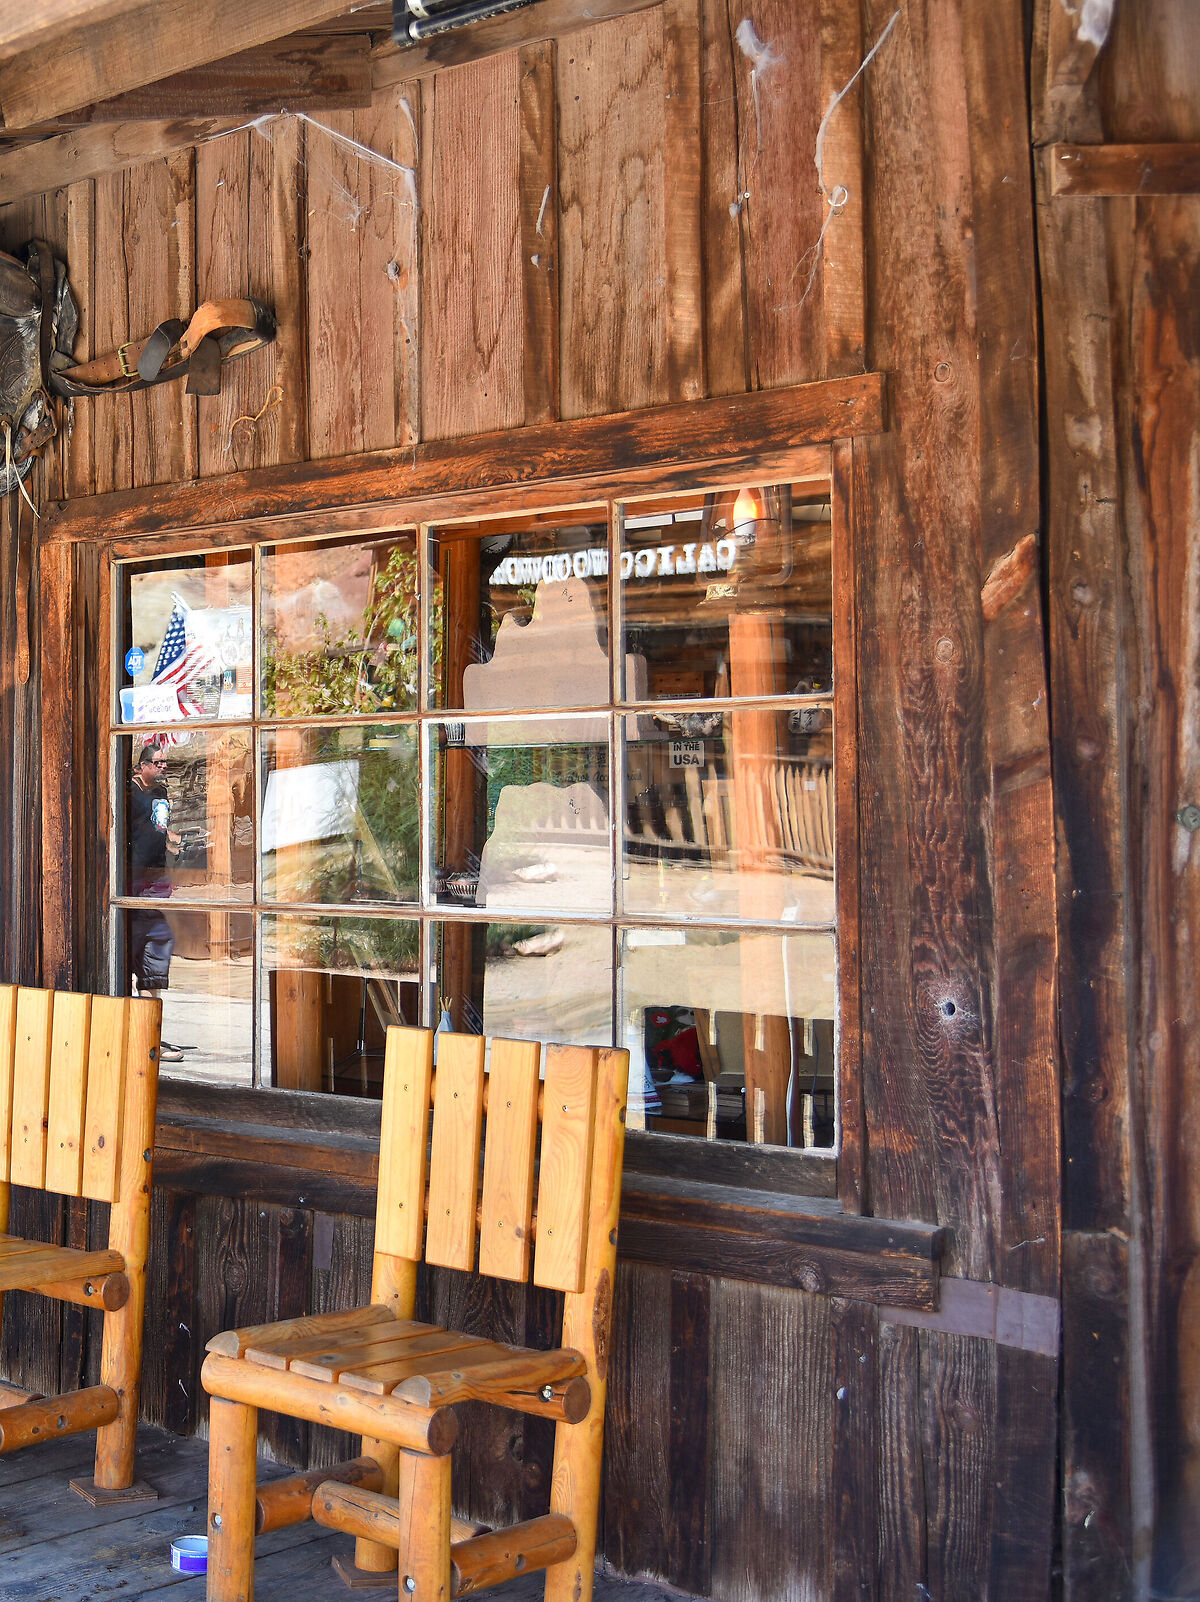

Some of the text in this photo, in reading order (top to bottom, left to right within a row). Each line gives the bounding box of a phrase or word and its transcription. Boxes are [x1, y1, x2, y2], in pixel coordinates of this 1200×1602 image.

[128, 656, 142, 665] ADT
[673, 742, 700, 751] IN THE
[673, 753, 700, 765] USA
